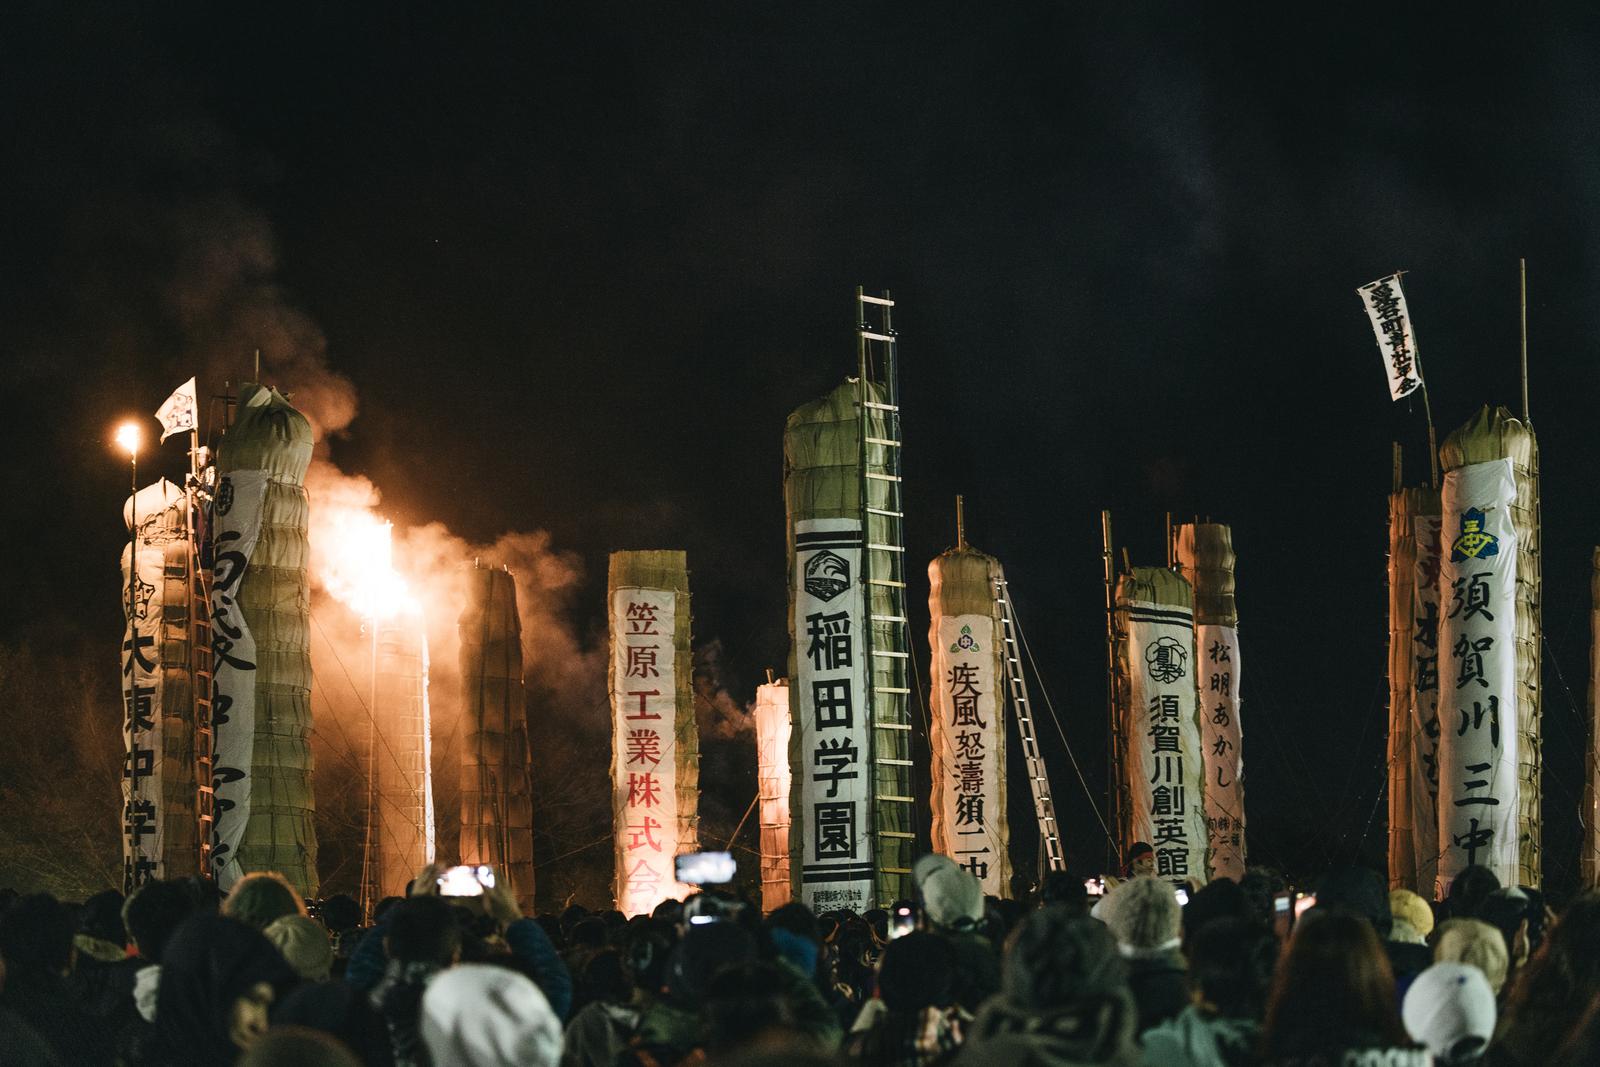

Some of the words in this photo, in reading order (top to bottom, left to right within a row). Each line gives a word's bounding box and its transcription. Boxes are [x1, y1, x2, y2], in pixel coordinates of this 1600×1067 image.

[625, 602, 662, 912] 笠原工業株式会
[805, 610, 857, 861] 稲田学園
[1147, 694, 1189, 876] 須賀川創英館
[1208, 640, 1233, 788] 松明あかし
[1447, 571, 1500, 864] 須賀川三中
